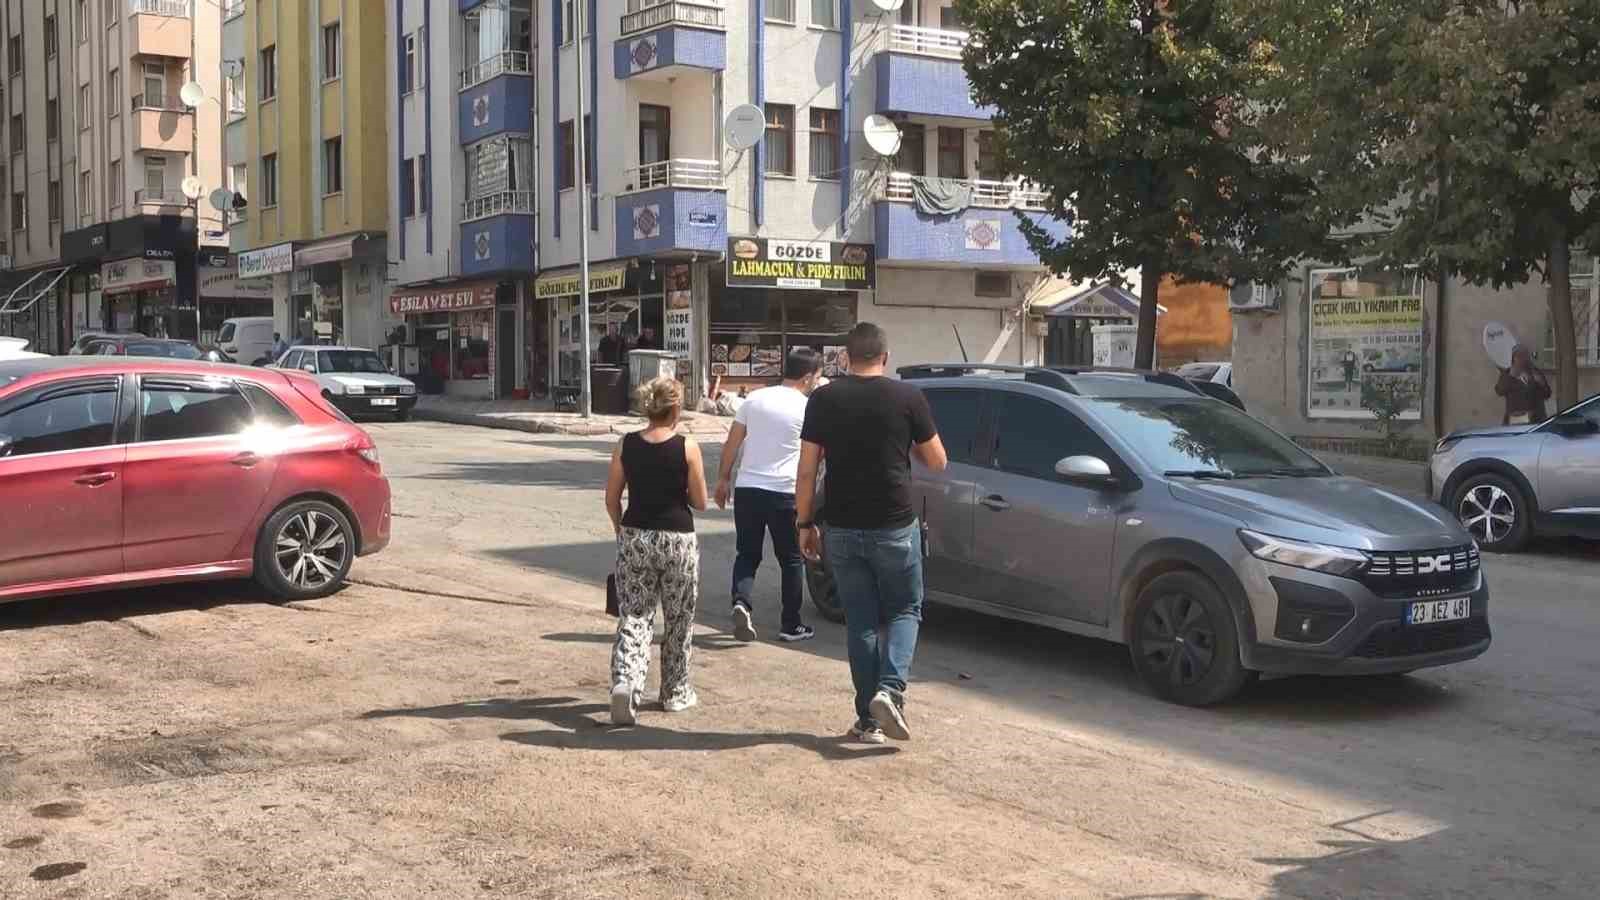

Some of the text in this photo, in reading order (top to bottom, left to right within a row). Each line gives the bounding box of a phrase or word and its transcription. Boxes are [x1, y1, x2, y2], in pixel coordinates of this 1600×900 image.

[775, 243, 823, 259] GÖZDE
[732, 261, 793, 278] LAHMACUN
[796, 264, 805, 278] &
[1412, 605, 1426, 623] 23
[1432, 601, 1449, 620] AEZ
[1453, 598, 1469, 617] 481
